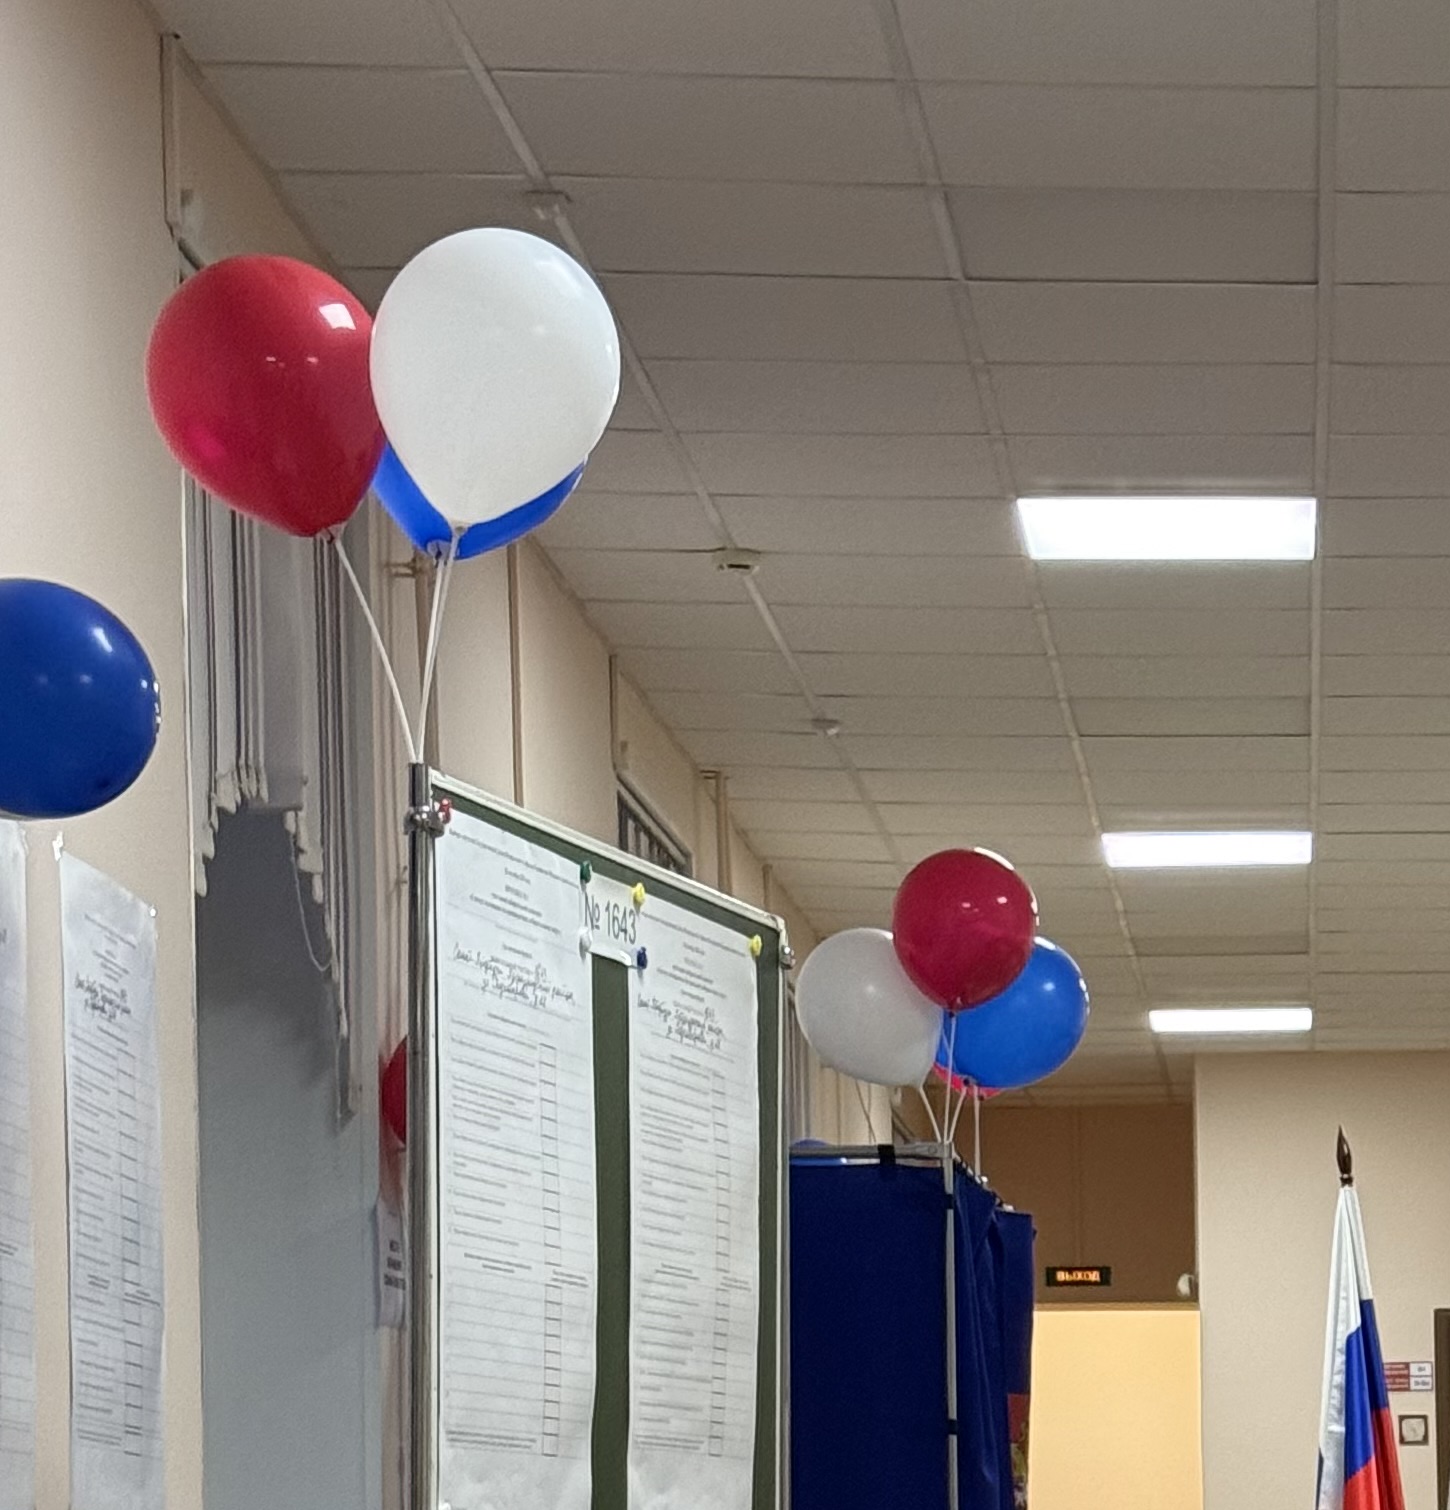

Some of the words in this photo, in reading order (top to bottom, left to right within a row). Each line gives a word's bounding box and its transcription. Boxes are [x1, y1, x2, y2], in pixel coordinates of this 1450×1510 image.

[584, 892, 600, 931] №
[605, 900, 637, 945] 1643
[1055, 1270, 1101, 1282] ВЫХОД
